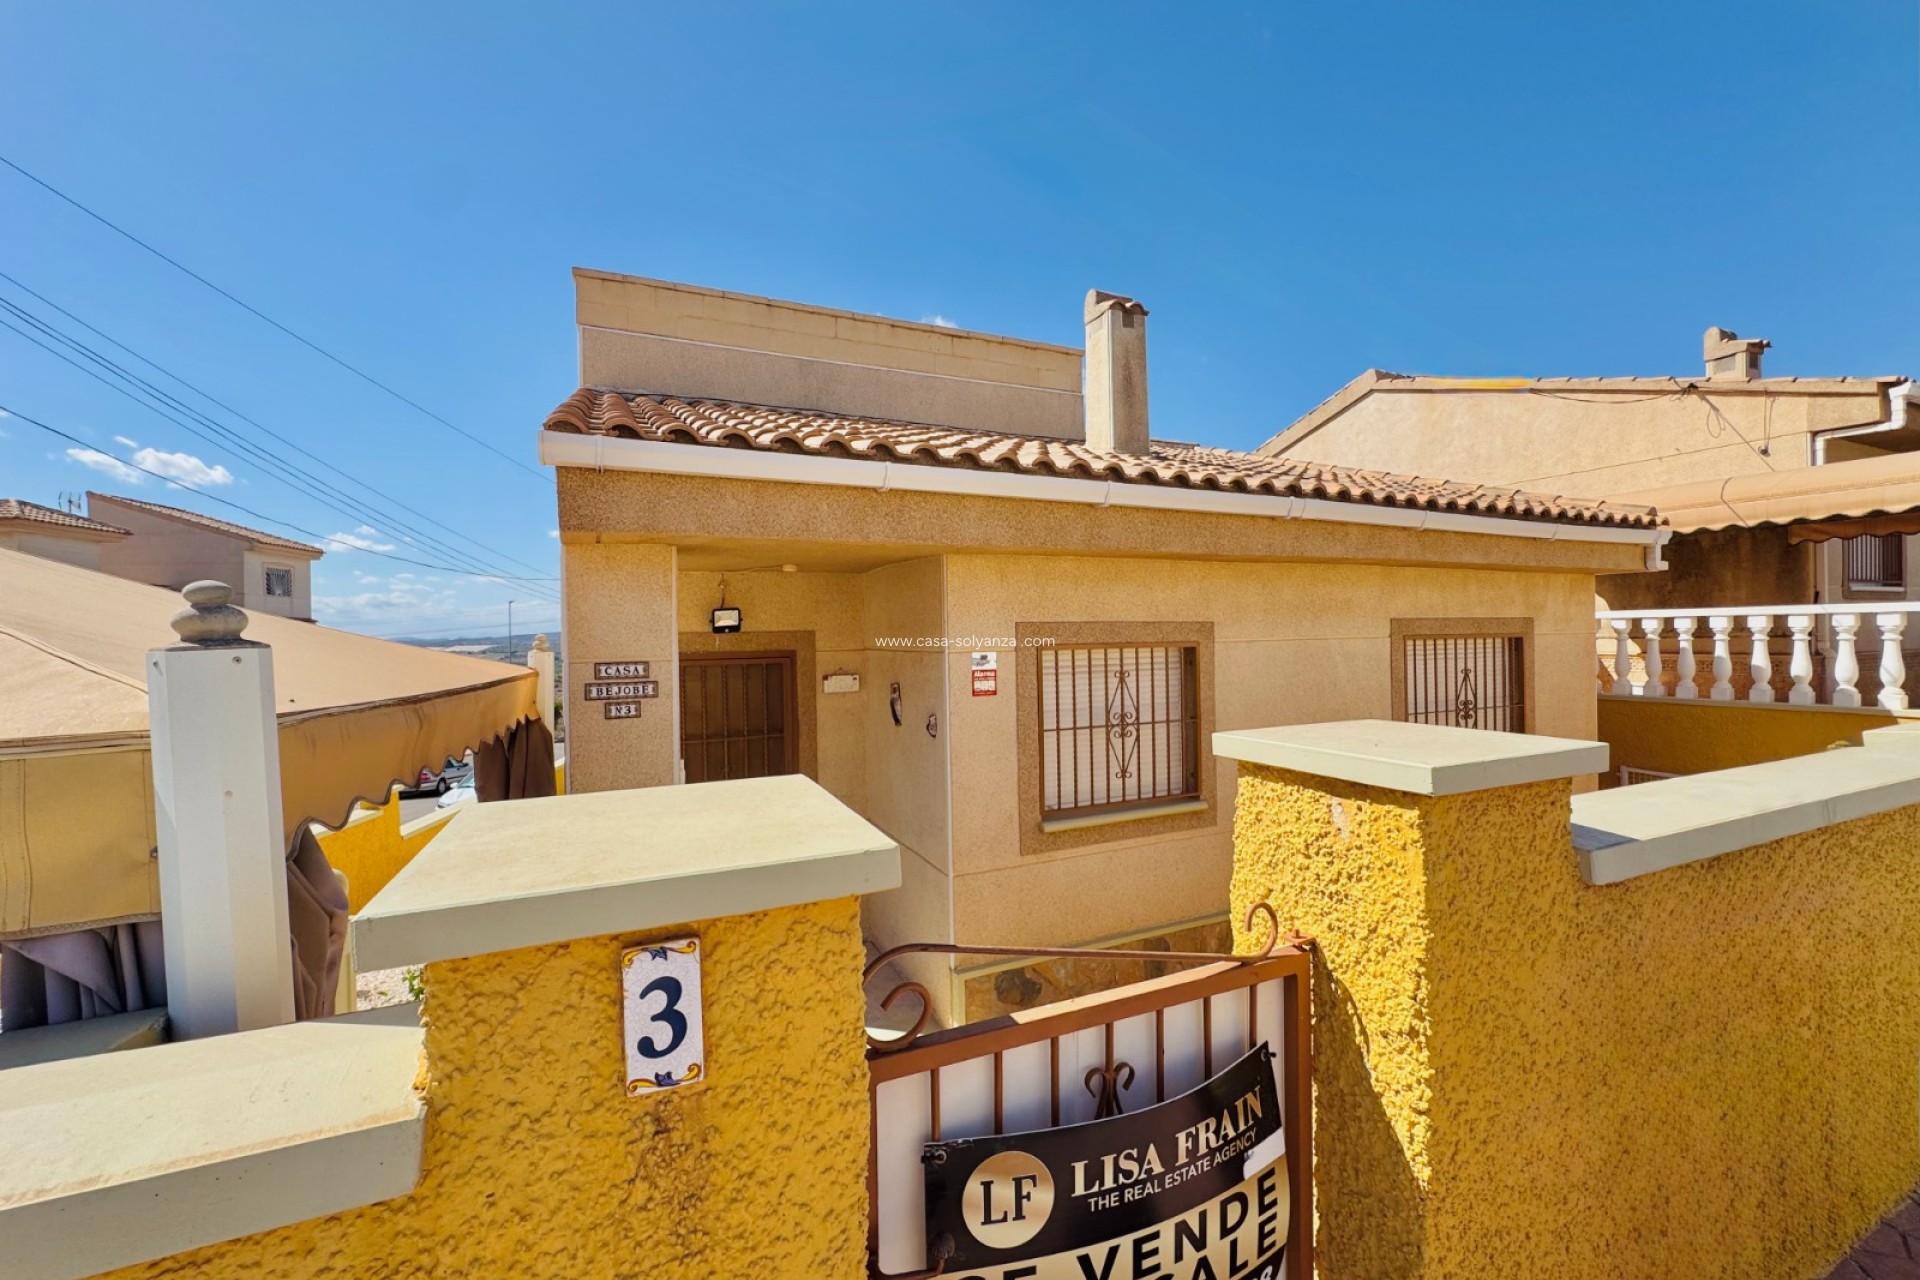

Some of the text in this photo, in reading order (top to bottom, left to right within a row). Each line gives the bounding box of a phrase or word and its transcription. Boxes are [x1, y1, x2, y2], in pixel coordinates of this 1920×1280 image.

[596, 685, 650, 696] BEJOBE
[604, 665, 641, 676] CASA
[637, 976, 688, 1059] 3
[1071, 1085, 1263, 1198] LISA FRAIN
[1088, 1127, 1258, 1213] THE REAL ESTATE AGENCY
[980, 1173, 1038, 1226] LF
[1076, 1166, 1279, 1280] VENDE
[1155, 1211, 1278, 1280] ALE
